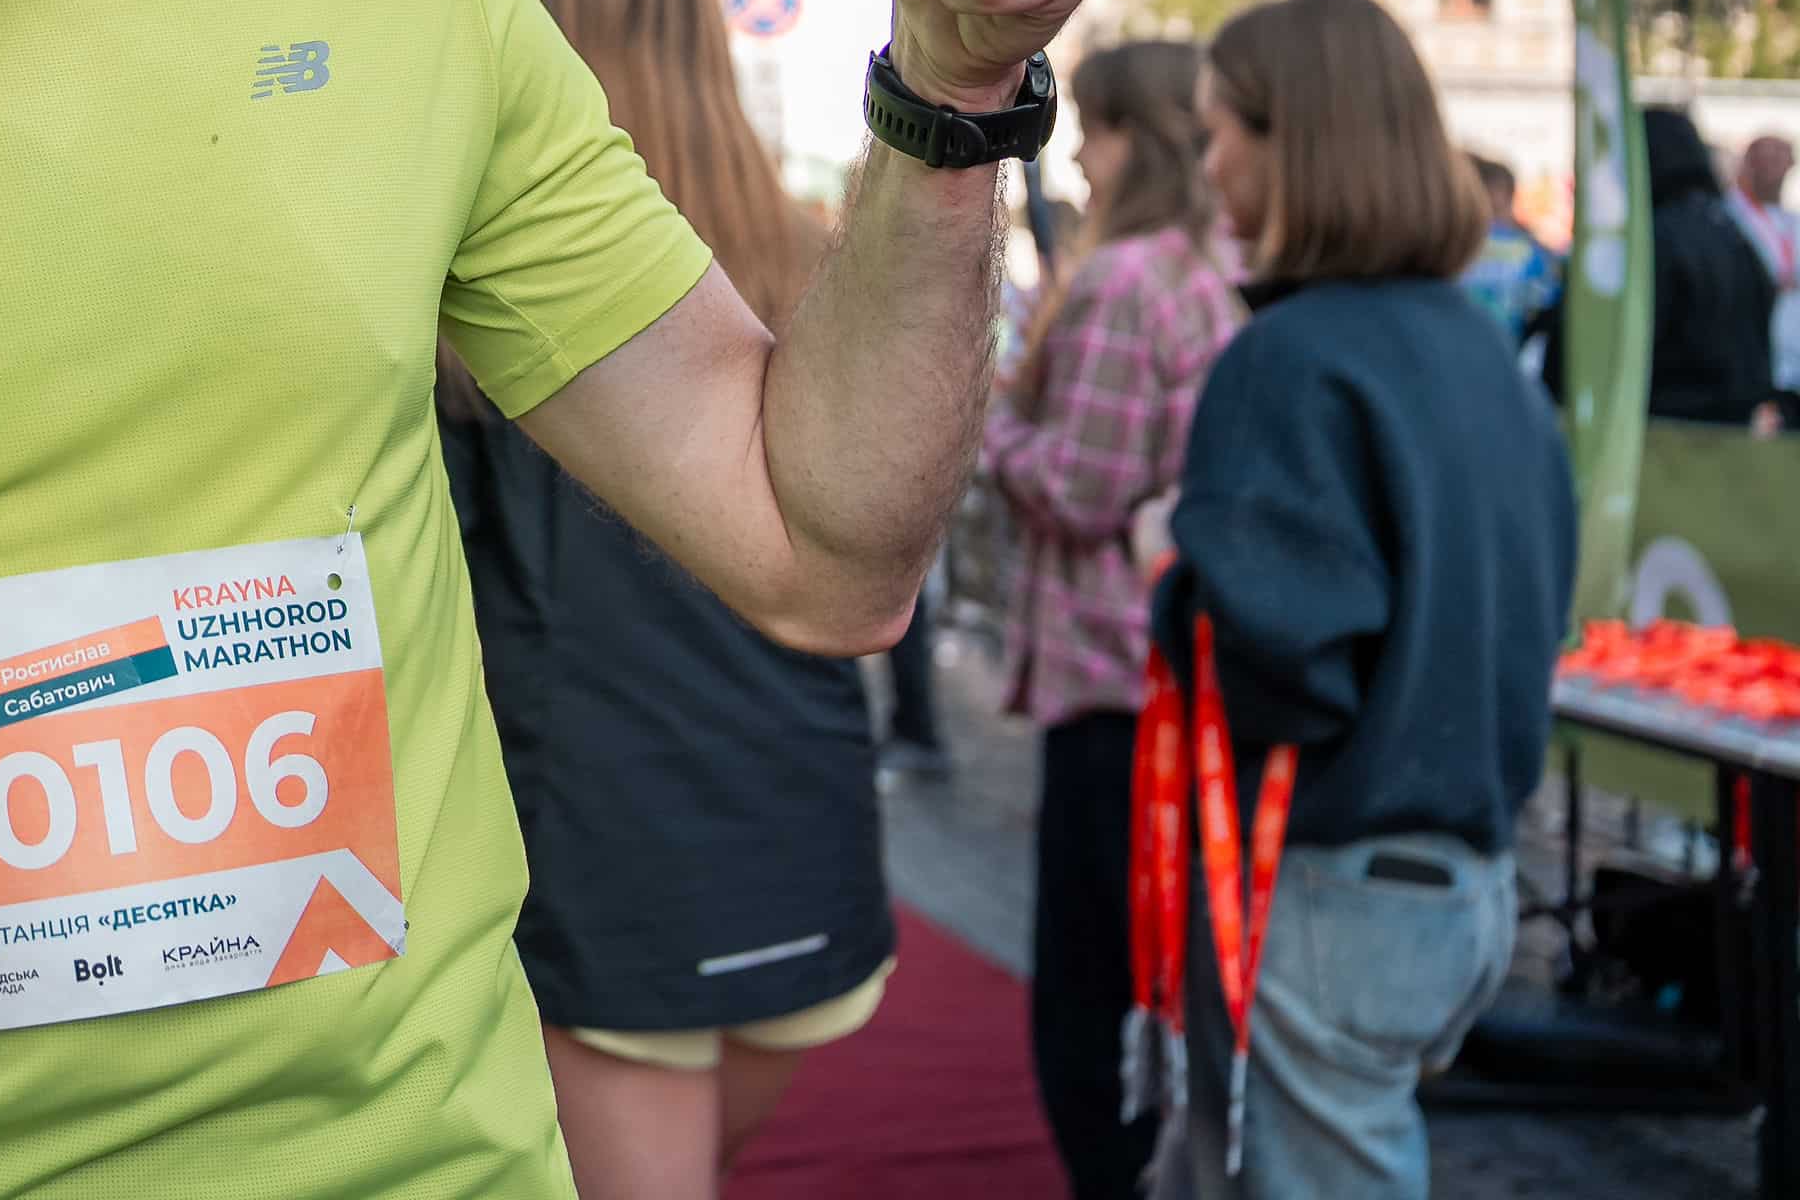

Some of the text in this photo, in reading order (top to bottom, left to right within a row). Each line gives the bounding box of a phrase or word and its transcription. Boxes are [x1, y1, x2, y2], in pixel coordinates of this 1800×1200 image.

[172, 575, 297, 611] KRAYNA
[177, 598, 348, 641] UZHHOROD
[0, 641, 111, 685] Ростислав
[184, 628, 352, 673] MARATHON
[4, 671, 116, 717] Сабатович
[98, 892, 238, 931] «ДЕСЯТКА»
[74, 953, 124, 986] Bolt
